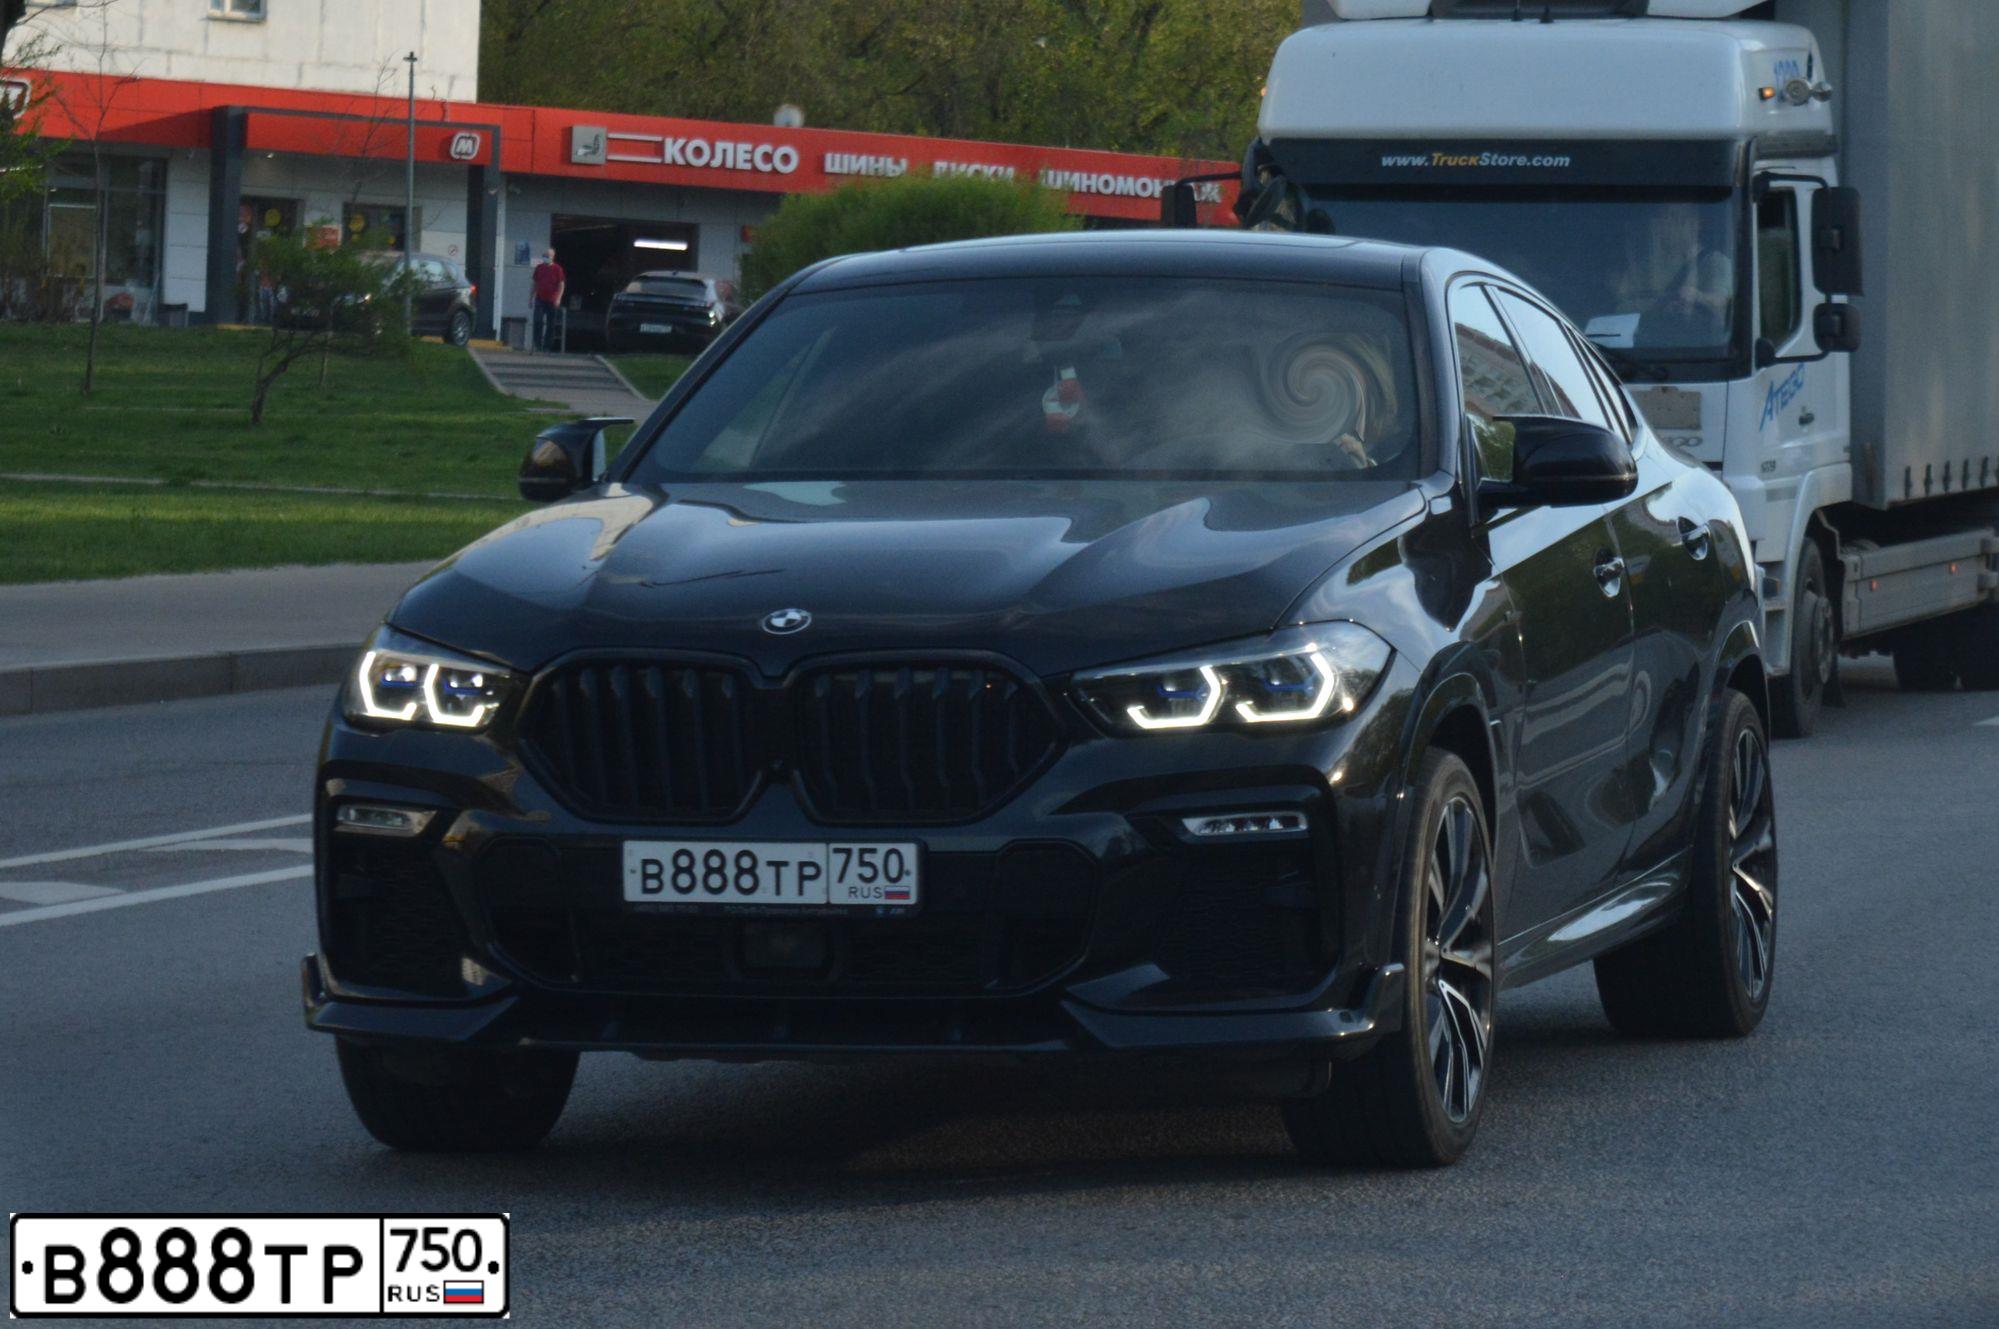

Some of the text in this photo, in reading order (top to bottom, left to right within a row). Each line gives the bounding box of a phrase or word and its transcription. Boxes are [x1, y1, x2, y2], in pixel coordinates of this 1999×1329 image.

[663, 137, 799, 174] КОЛЕСО
[1381, 152, 1570, 167] www.TruckStore.com
[824, 152, 909, 177] ШИНЫ
[1039, 168, 1222, 203] ШИНОМОНЖ
[639, 847, 905, 896] В888ТР 750
[848, 886, 883, 899] RUS
